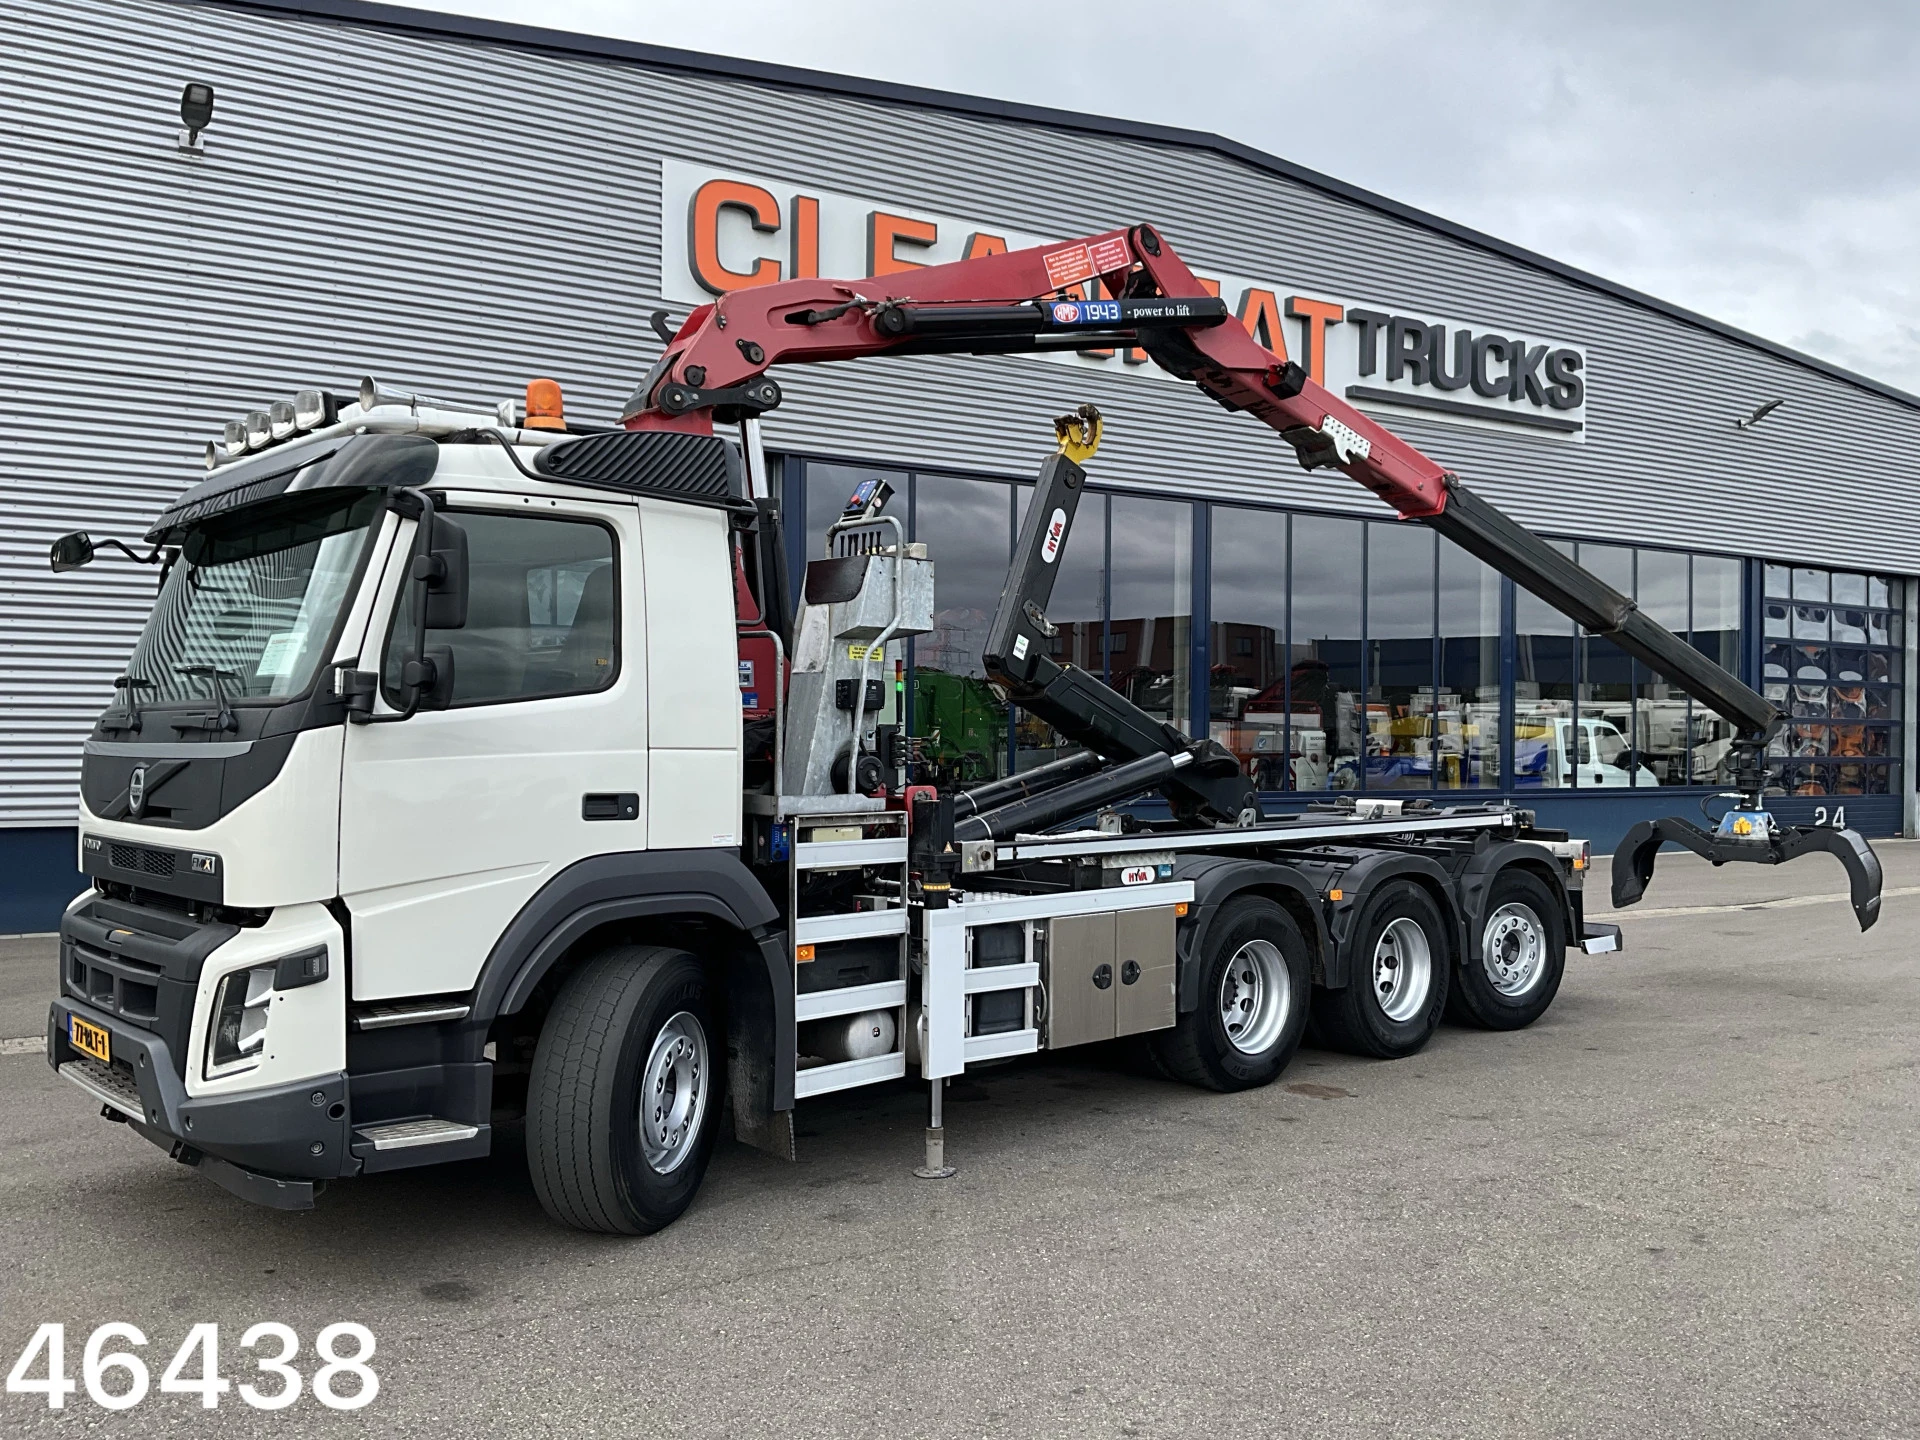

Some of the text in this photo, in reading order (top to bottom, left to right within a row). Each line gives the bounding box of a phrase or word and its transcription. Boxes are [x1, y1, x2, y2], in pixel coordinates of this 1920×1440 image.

[1056, 305, 1078, 321] HMF
[1085, 304, 1119, 320] 1943
[1133, 307, 1162, 318] power
[1165, 306, 1174, 316] to
[1176, 304, 1190, 316] lift
[1347, 308, 1583, 410] TRUCKS
[1047, 522, 1063, 553] HYVA
[1815, 806, 1846, 830] 24
[1128, 869, 1148, 882] HYVA
